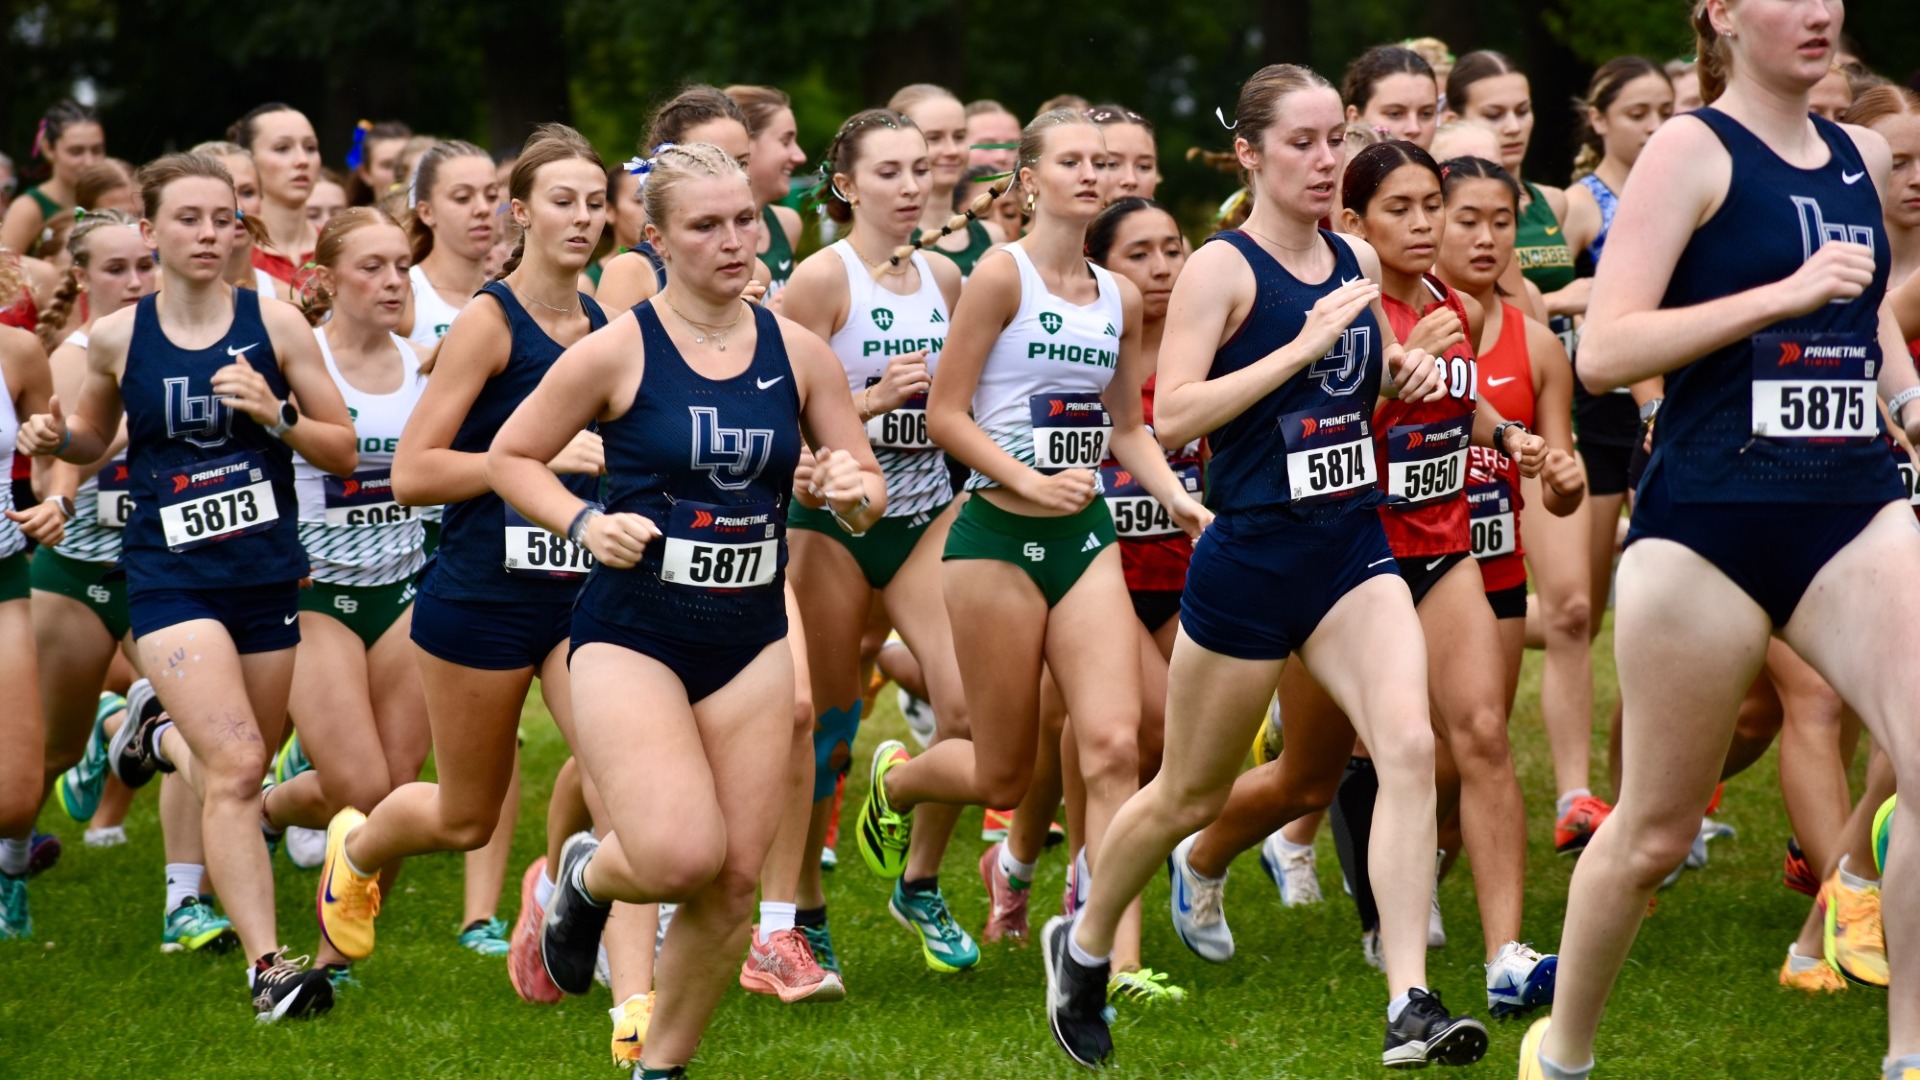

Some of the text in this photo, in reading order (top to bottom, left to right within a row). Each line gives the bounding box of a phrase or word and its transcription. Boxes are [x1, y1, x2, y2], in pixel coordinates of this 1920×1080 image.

[1804, 346, 1867, 358] PRIMETIME
[1319, 411, 1361, 428] PRIMETIME
[1780, 386, 1864, 430] 5875
[1320, 425, 1346, 435] TIMING
[1425, 426, 1462, 443] PRIMETIME
[688, 406, 775, 490] LU
[1049, 431, 1104, 464] 6058
[191, 461, 249, 483] PRIMETIME
[1308, 444, 1365, 491] 5874
[1405, 455, 1458, 498] 5950
[181, 490, 258, 537] 5873
[714, 514, 768, 526] PRIMETIME
[1115, 500, 1181, 533] 594
[690, 546, 762, 584] 5877
